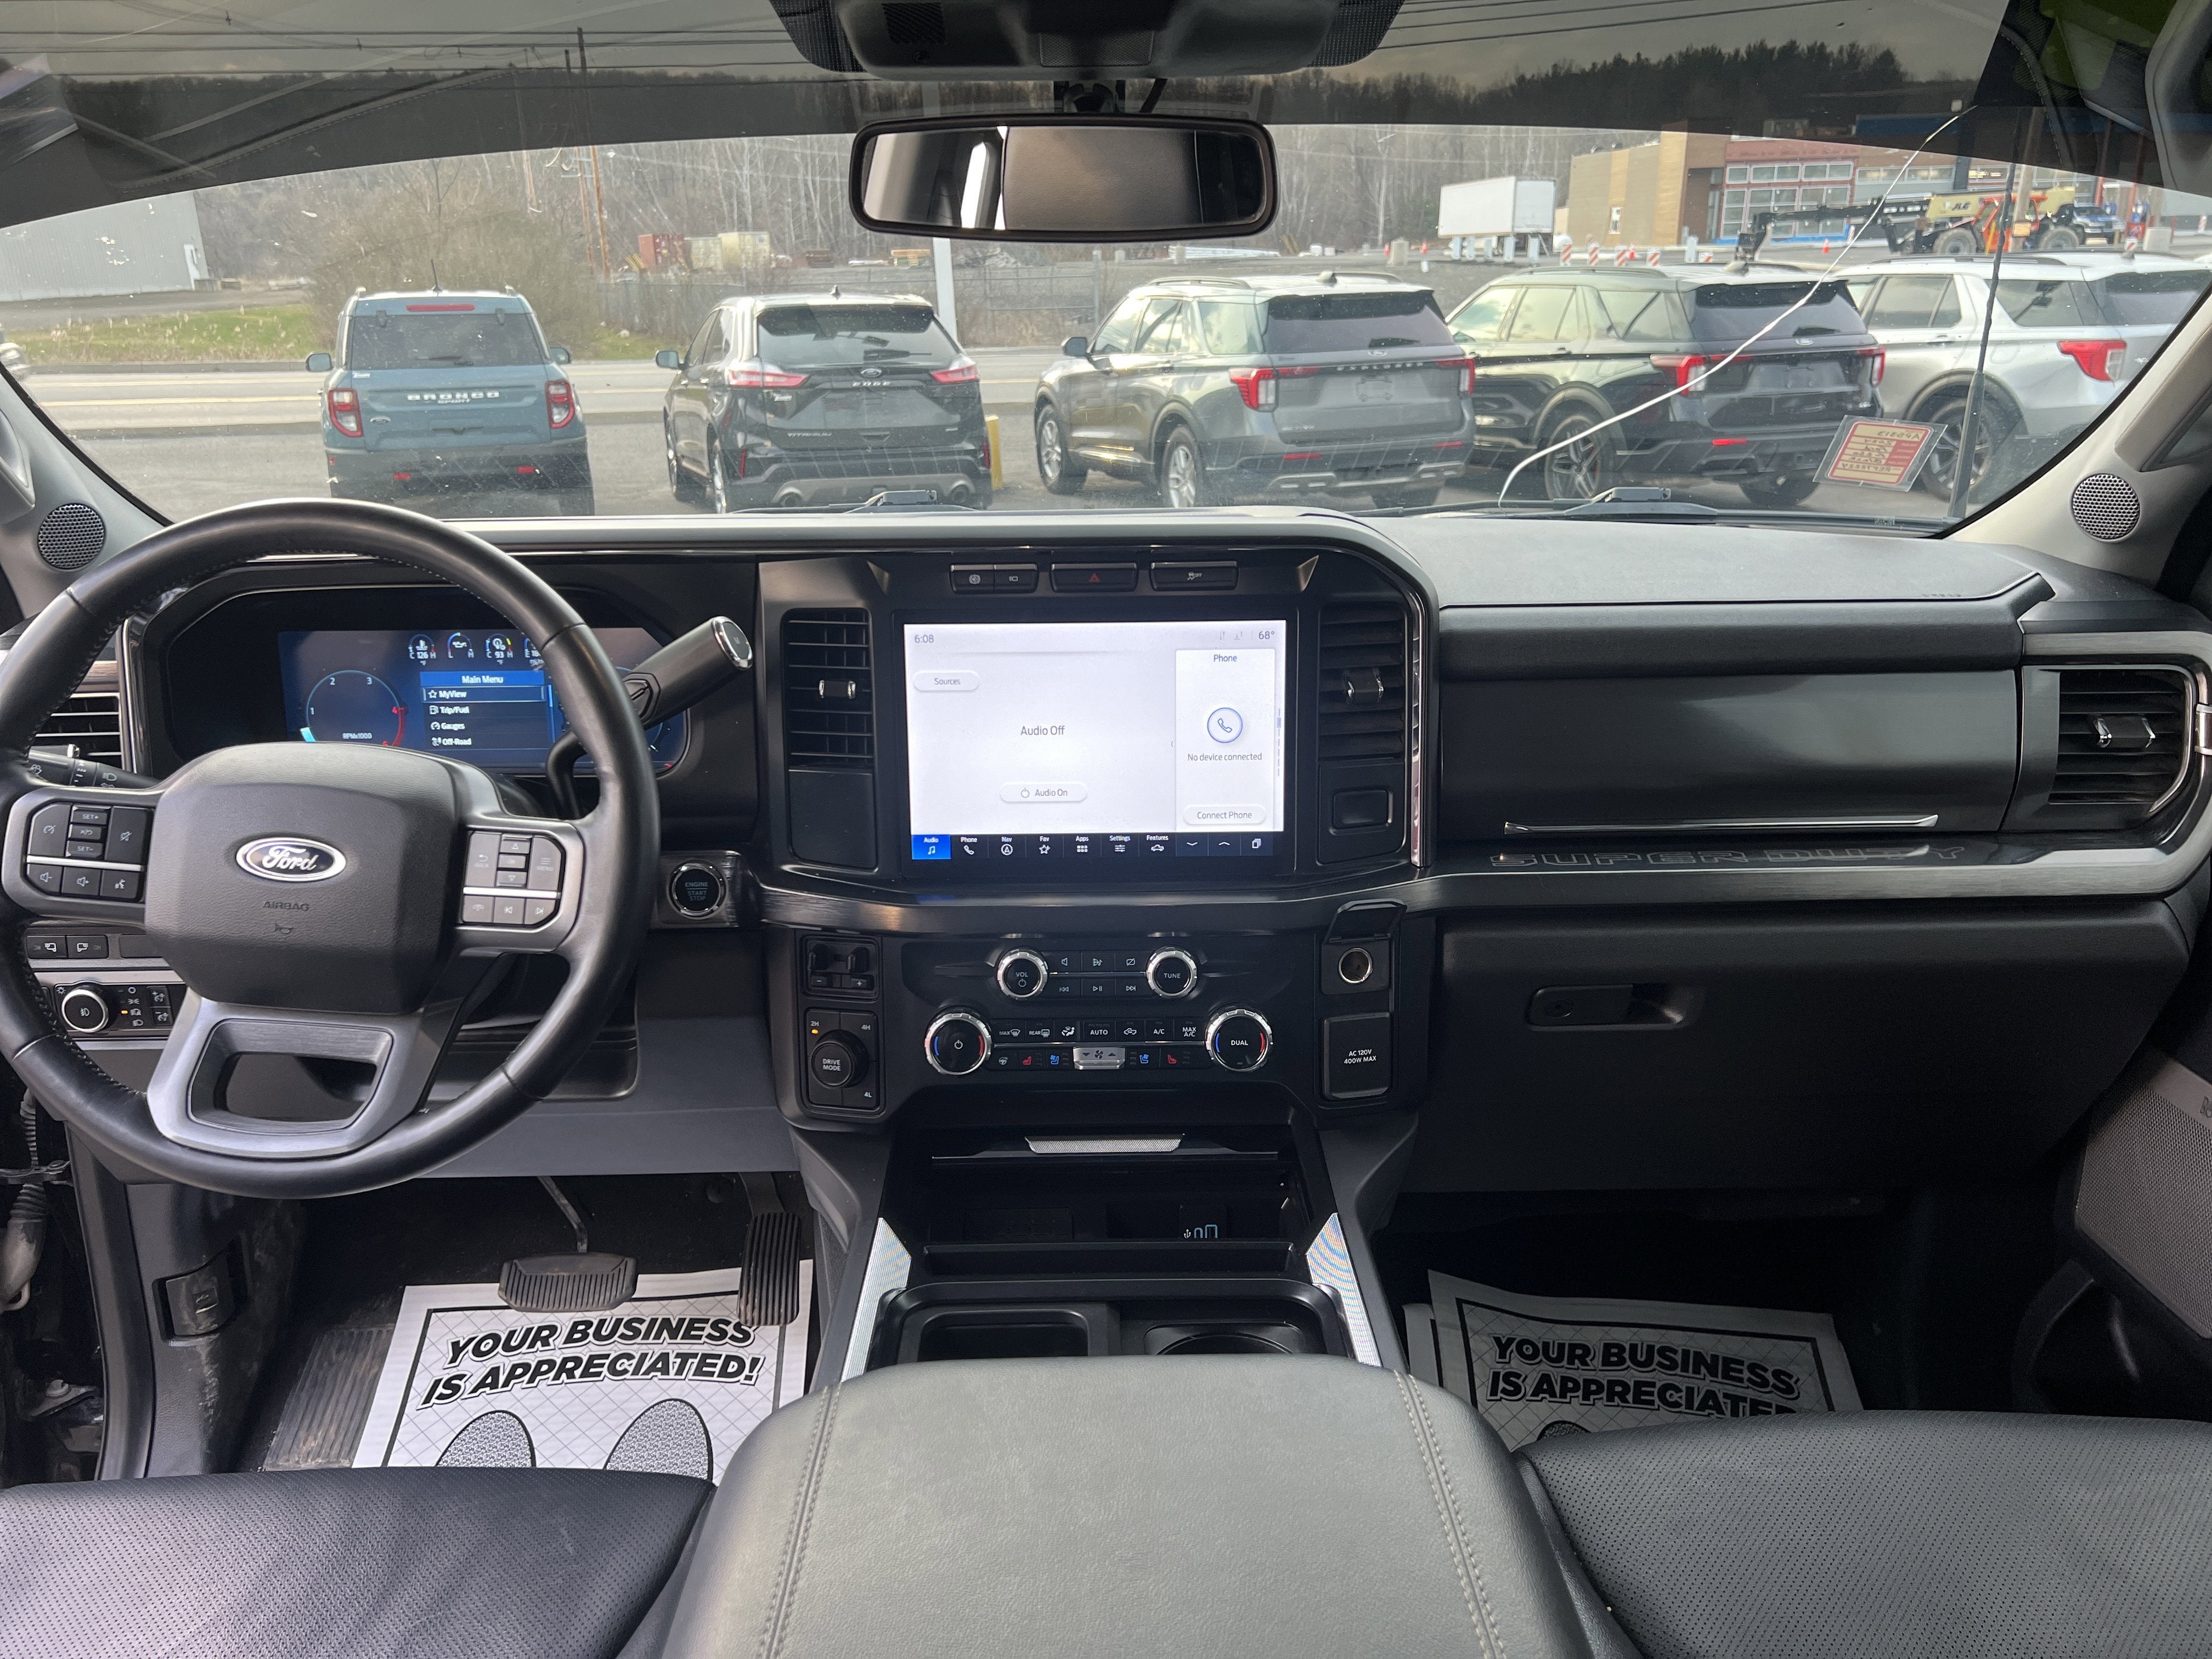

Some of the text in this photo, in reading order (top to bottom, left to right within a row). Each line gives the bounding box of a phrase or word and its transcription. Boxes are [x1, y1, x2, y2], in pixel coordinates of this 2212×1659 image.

[1336, 362, 1424, 371] EXPLORER
[407, 391, 500, 401] BRONCO
[914, 634, 935, 644] 6:08
[1258, 631, 1275, 640] 68°
[1214, 654, 1238, 662] Phone
[329, 676, 373, 685] 2 3
[461, 675, 504, 684] Main Menu
[934, 677, 961, 686] Sources
[438, 690, 467, 699] MyView
[392, 706, 399, 714] 4
[439, 706, 470, 714] Trip/Fuel
[441, 723, 465, 731] Gauges
[1020, 724, 1065, 736] Audio Off
[442, 737, 472, 746] Off-Road
[1187, 752, 1263, 761] No device connected
[1035, 788, 1068, 798] Audio On
[1197, 811, 1252, 820] Connect Phone
[262, 845, 319, 871] Ford
[1489, 845, 1966, 867] SUPER DUTY
[262, 900, 310, 911] AIRBAG
[447, 1317, 754, 1367] YOUR BUSINESS
[1493, 1336, 1800, 1397] YOUR BUSINESS
[421, 1352, 764, 1408] IS APPRECIATED!
[1490, 1370, 1526, 1401] IS
